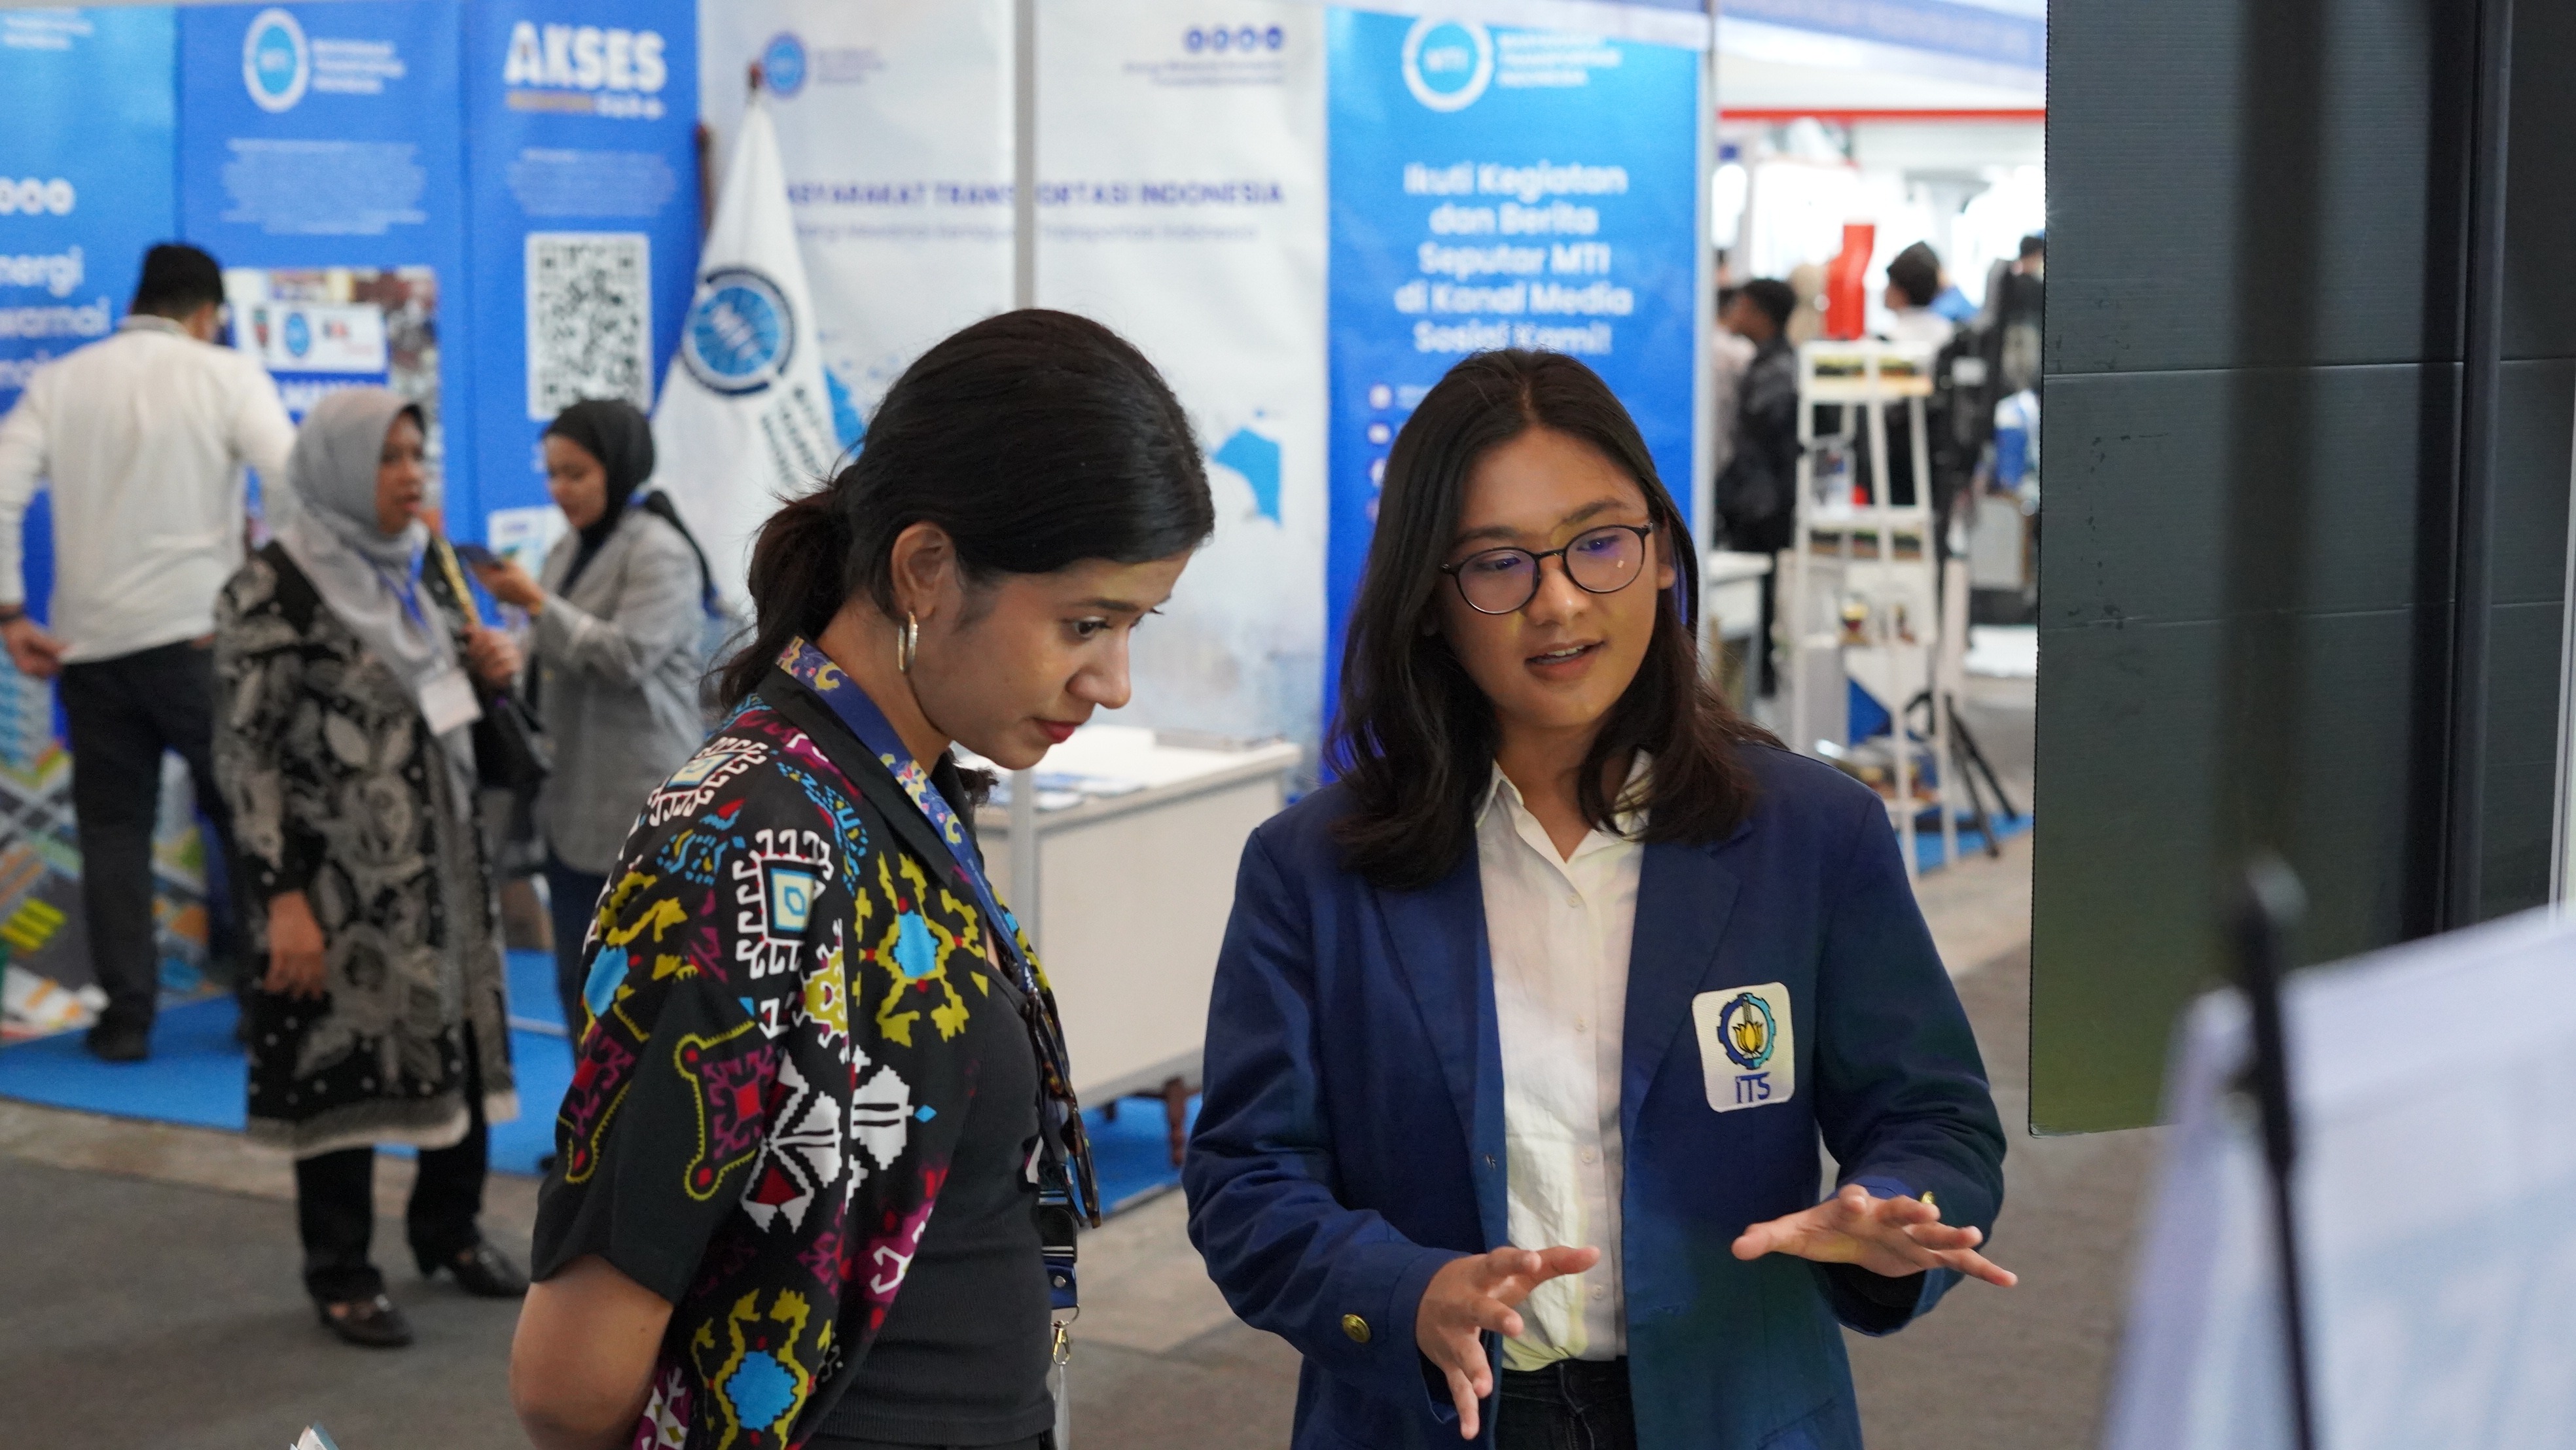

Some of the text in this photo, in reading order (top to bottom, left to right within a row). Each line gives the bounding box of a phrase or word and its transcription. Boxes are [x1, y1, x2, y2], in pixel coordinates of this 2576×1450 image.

[504, 22, 668, 91] AKSES
[785, 181, 1286, 207] ASYARAKAT TRANSORTASI INDONESIA
[1404, 160, 1628, 202] Ikuti Kegiatan
[1429, 200, 1598, 234] dan Berita
[1418, 242, 1610, 281] Seputar MTI
[1395, 279, 1634, 314] di Kanal Media
[1414, 320, 1509, 352] Sosial
[1735, 1071, 1771, 1103] ITS
